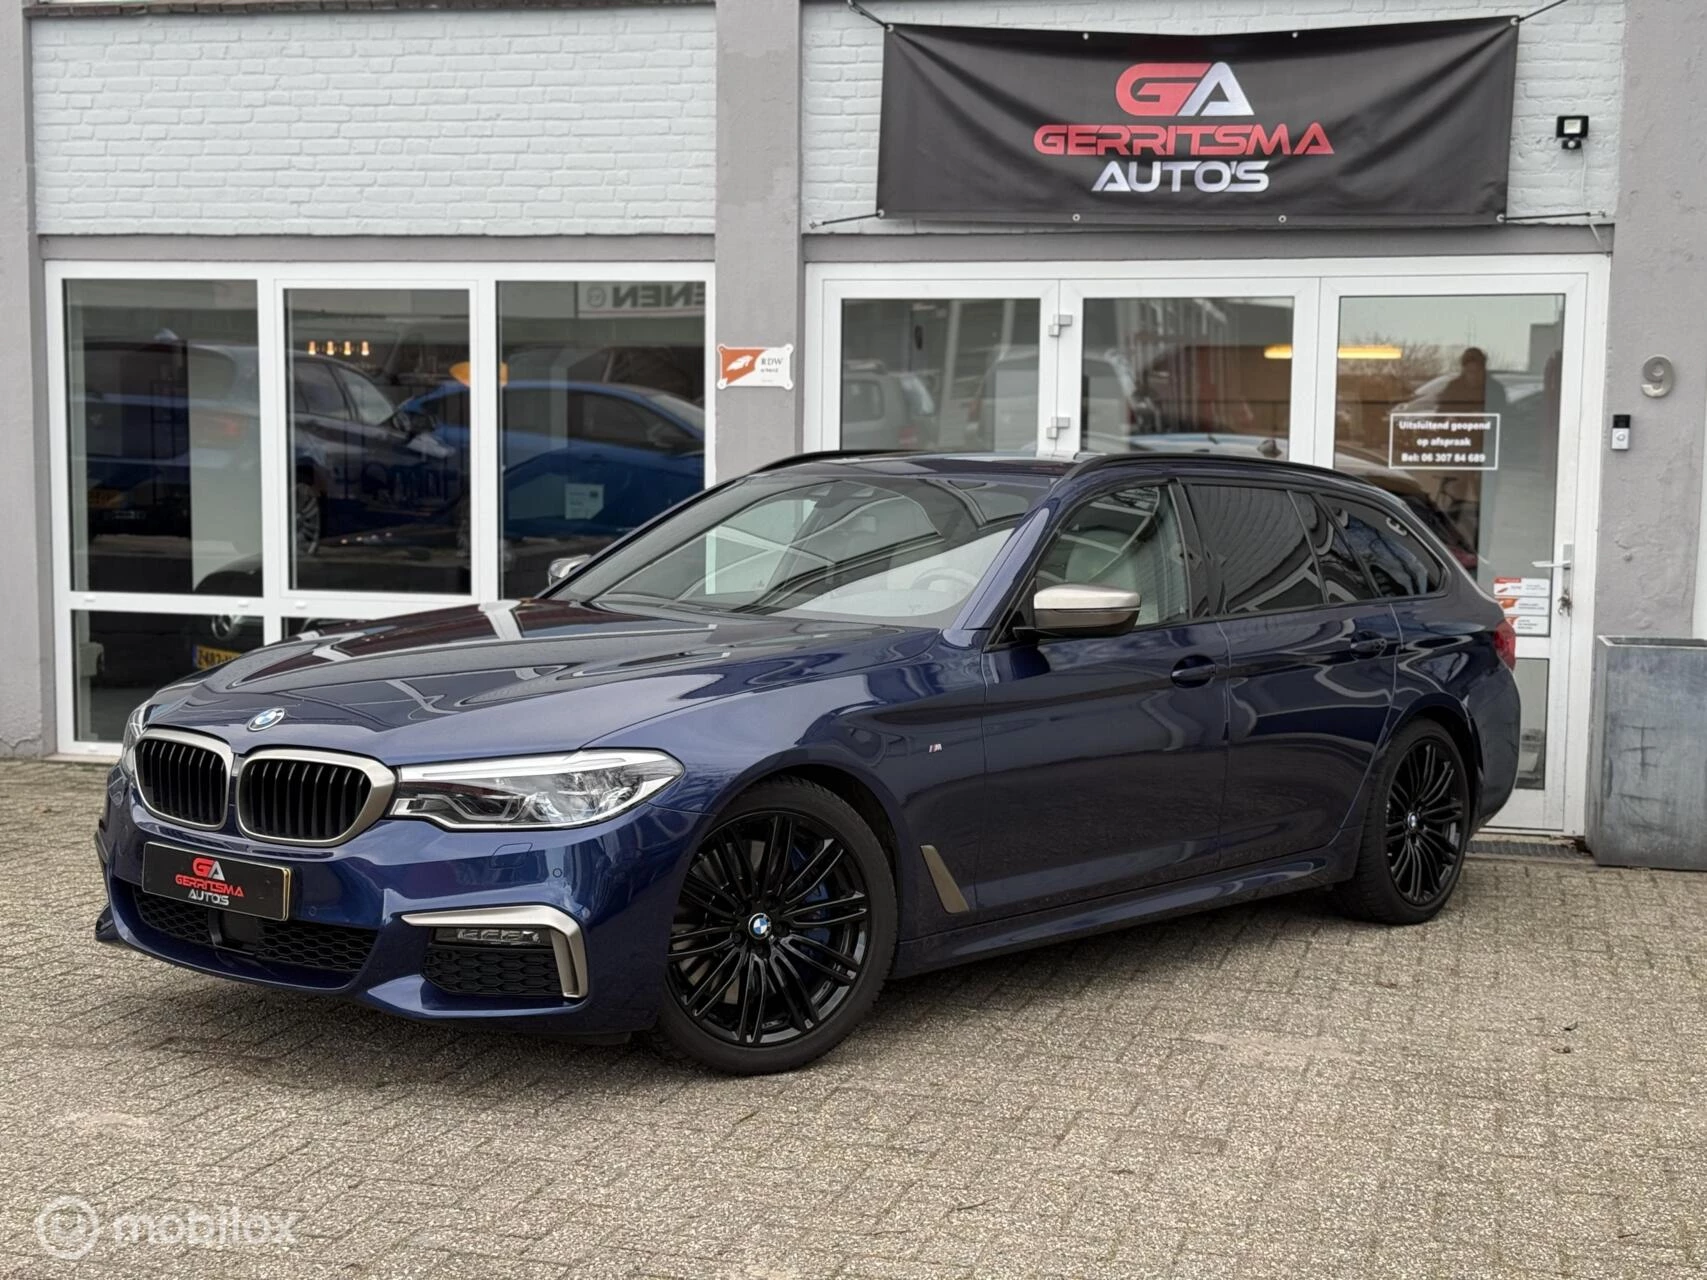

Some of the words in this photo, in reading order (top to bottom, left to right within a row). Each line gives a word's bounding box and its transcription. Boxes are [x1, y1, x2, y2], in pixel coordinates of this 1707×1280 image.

[1115, 61, 1255, 117] GA
[1033, 121, 1334, 156] GERRITSMA
[1091, 160, 1270, 193] AUTO'S
[761, 357, 783, 366] RDW
[1641, 355, 1675, 398] 9
[1399, 421, 1449, 430] Uitsluitend
[1451, 421, 1491, 432] geopend
[1417, 438, 1429, 447] op
[1431, 437, 1471, 447] afspraak
[1421, 453, 1433, 462] 06
[1435, 453, 1451, 462] 307
[193, 857, 225, 881] GA
[175, 874, 244, 897] GERRITSMA
